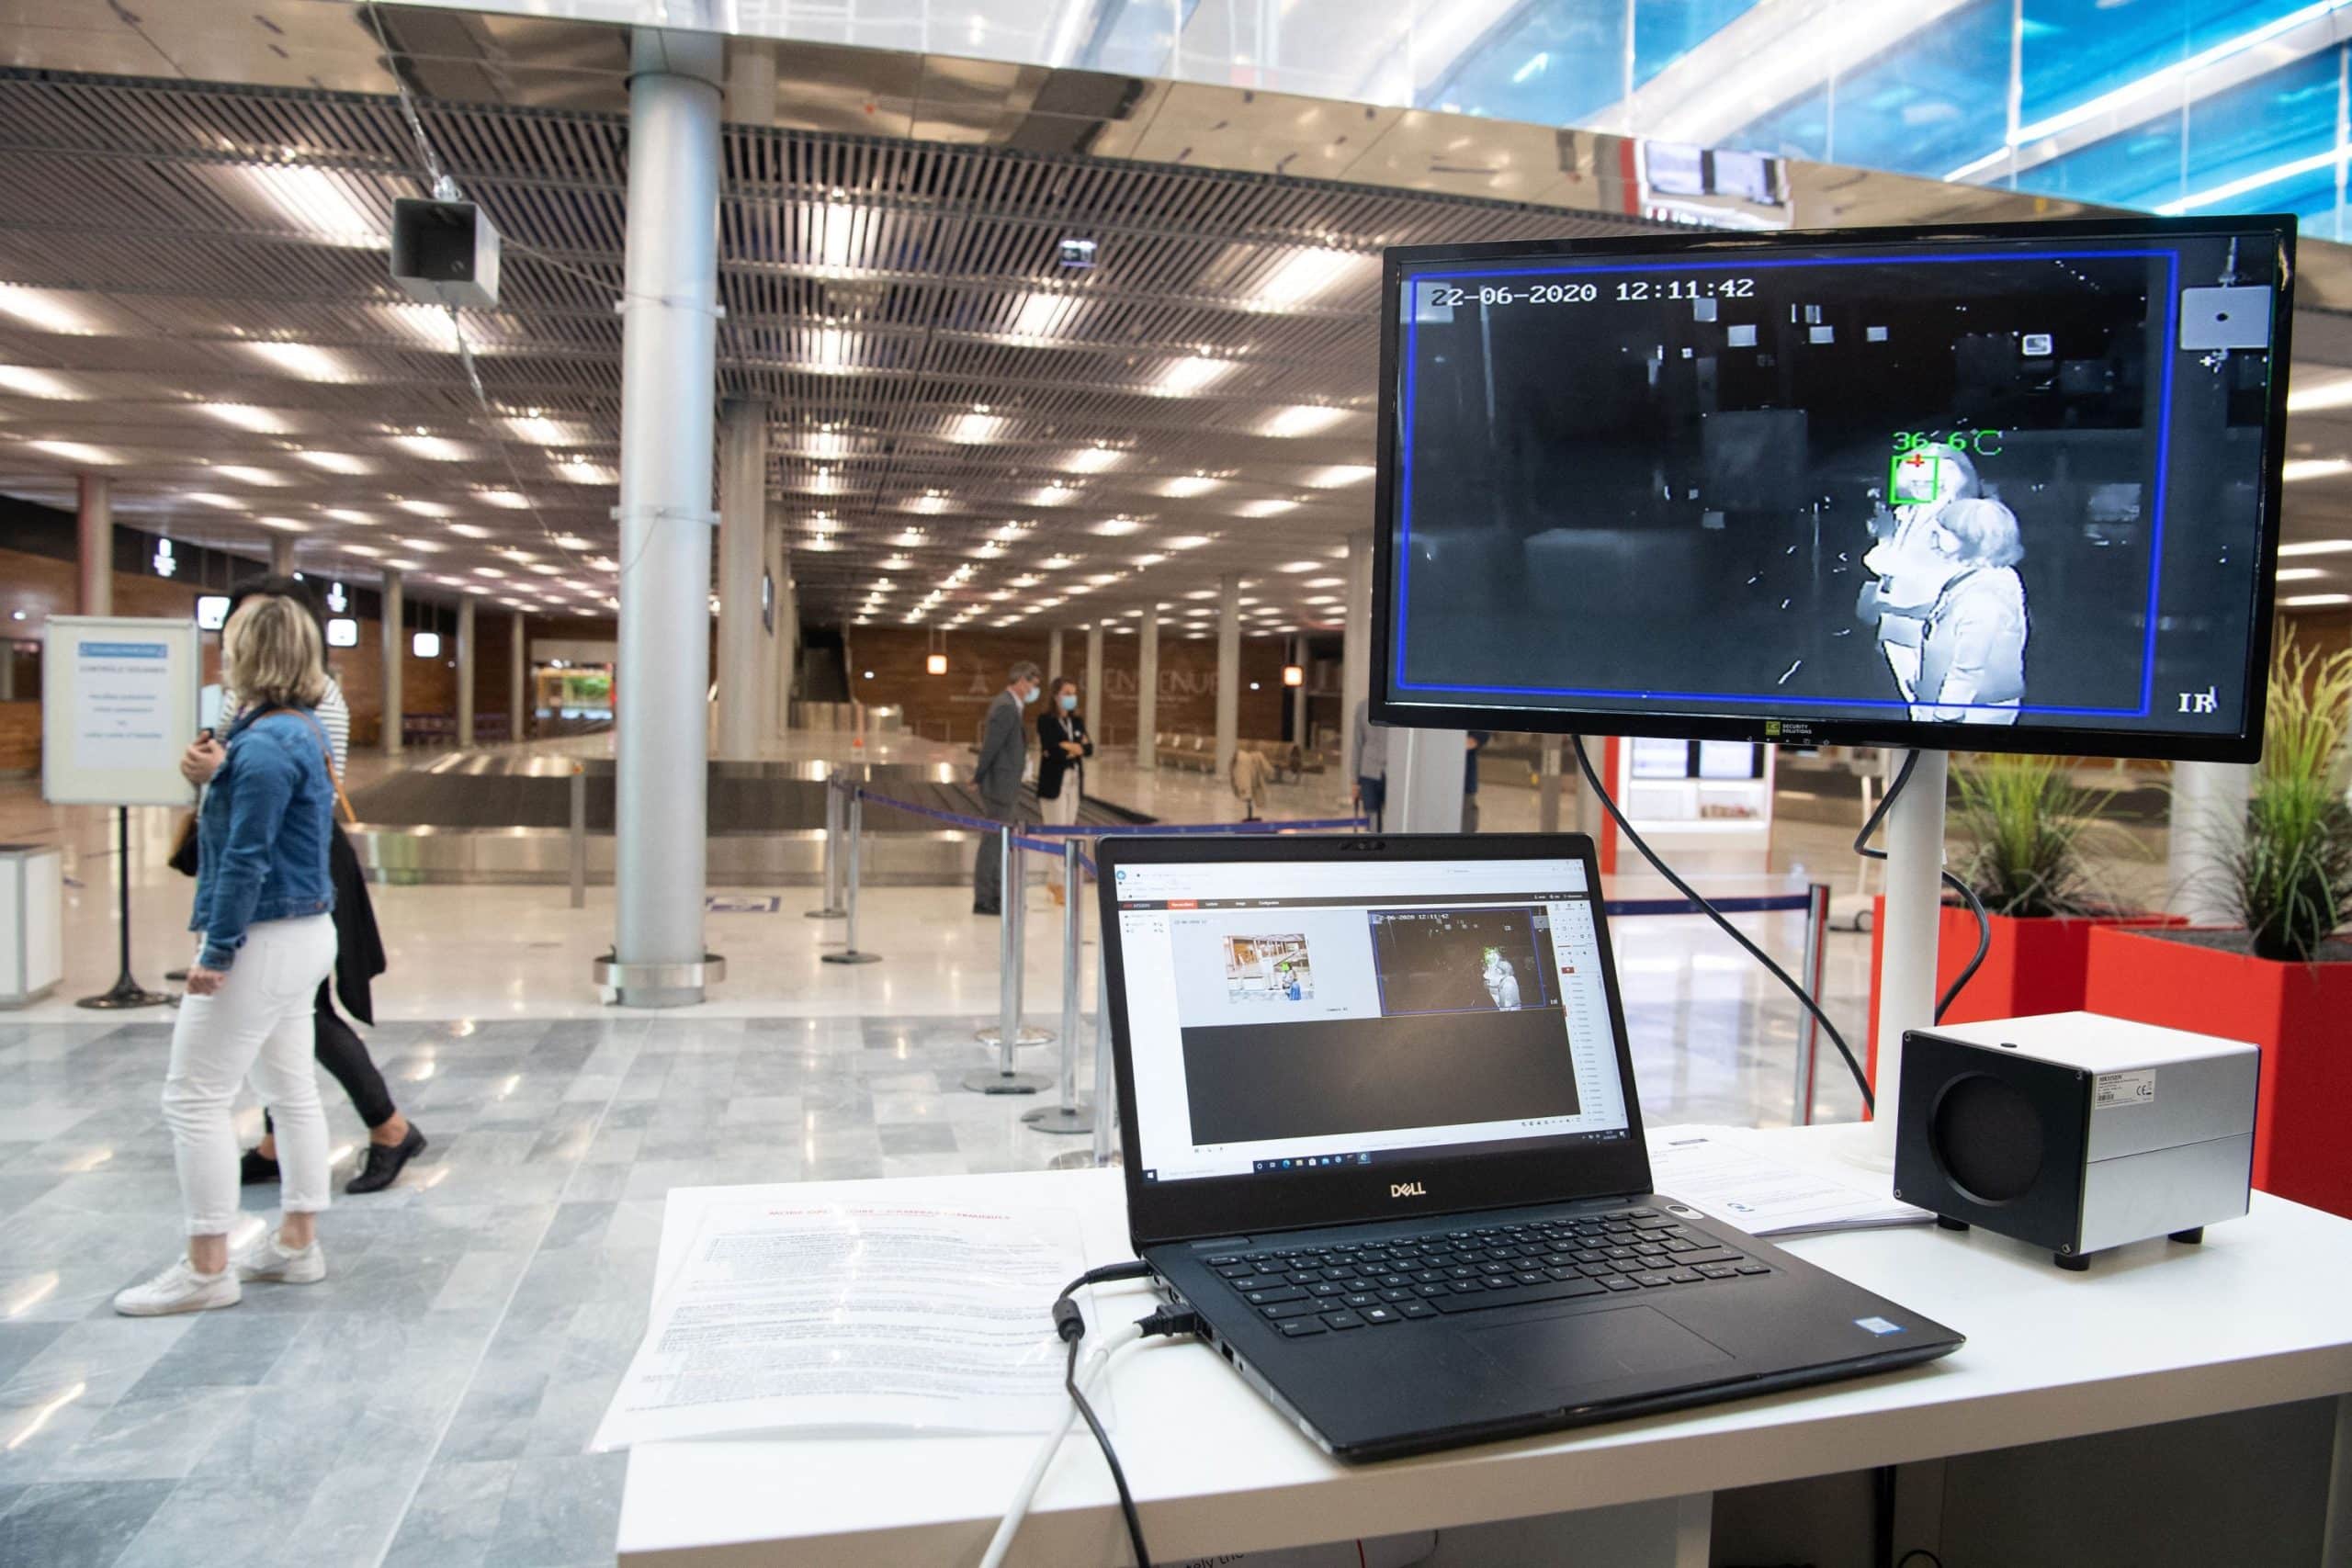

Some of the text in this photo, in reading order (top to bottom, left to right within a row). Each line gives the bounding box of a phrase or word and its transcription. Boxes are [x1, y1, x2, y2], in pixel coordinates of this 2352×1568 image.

[1430, 279, 1755, 306] 22-06-2020 12:11:42
[2177, 693, 2213, 713] IR
[1390, 1181, 1427, 1198] DELL
